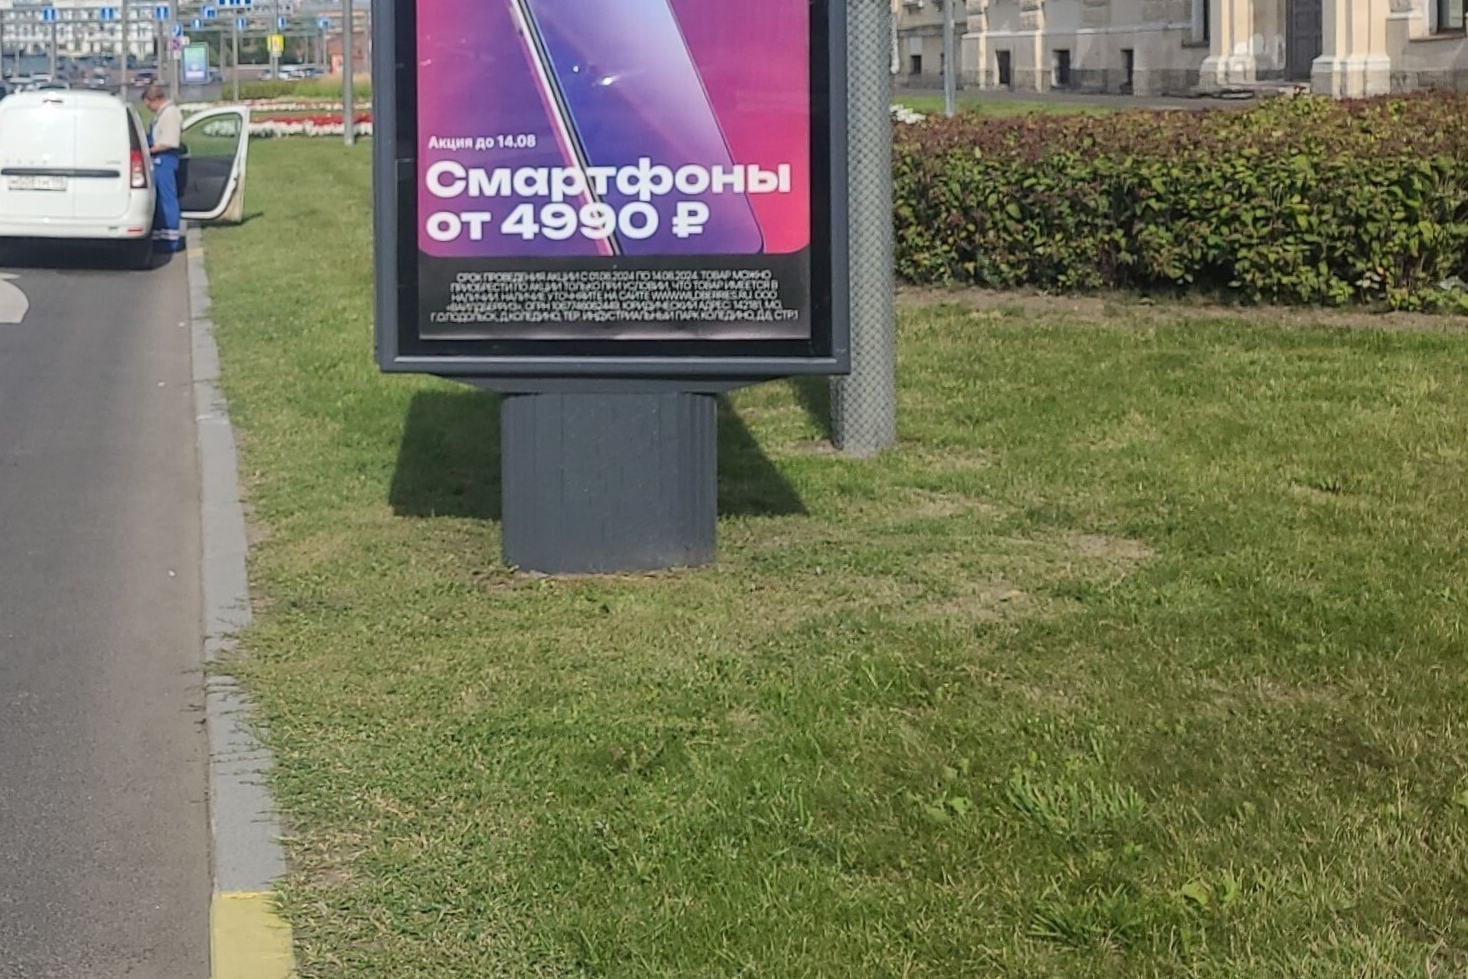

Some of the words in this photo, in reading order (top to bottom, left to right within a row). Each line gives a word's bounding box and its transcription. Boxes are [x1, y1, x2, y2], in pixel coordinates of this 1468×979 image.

[428, 136, 473, 151] Акция
[475, 136, 495, 151] до
[497, 134, 537, 149] 14.08
[425, 157, 792, 202] Смартфоны
[426, 211, 492, 241] от
[500, 201, 660, 241] 4990
